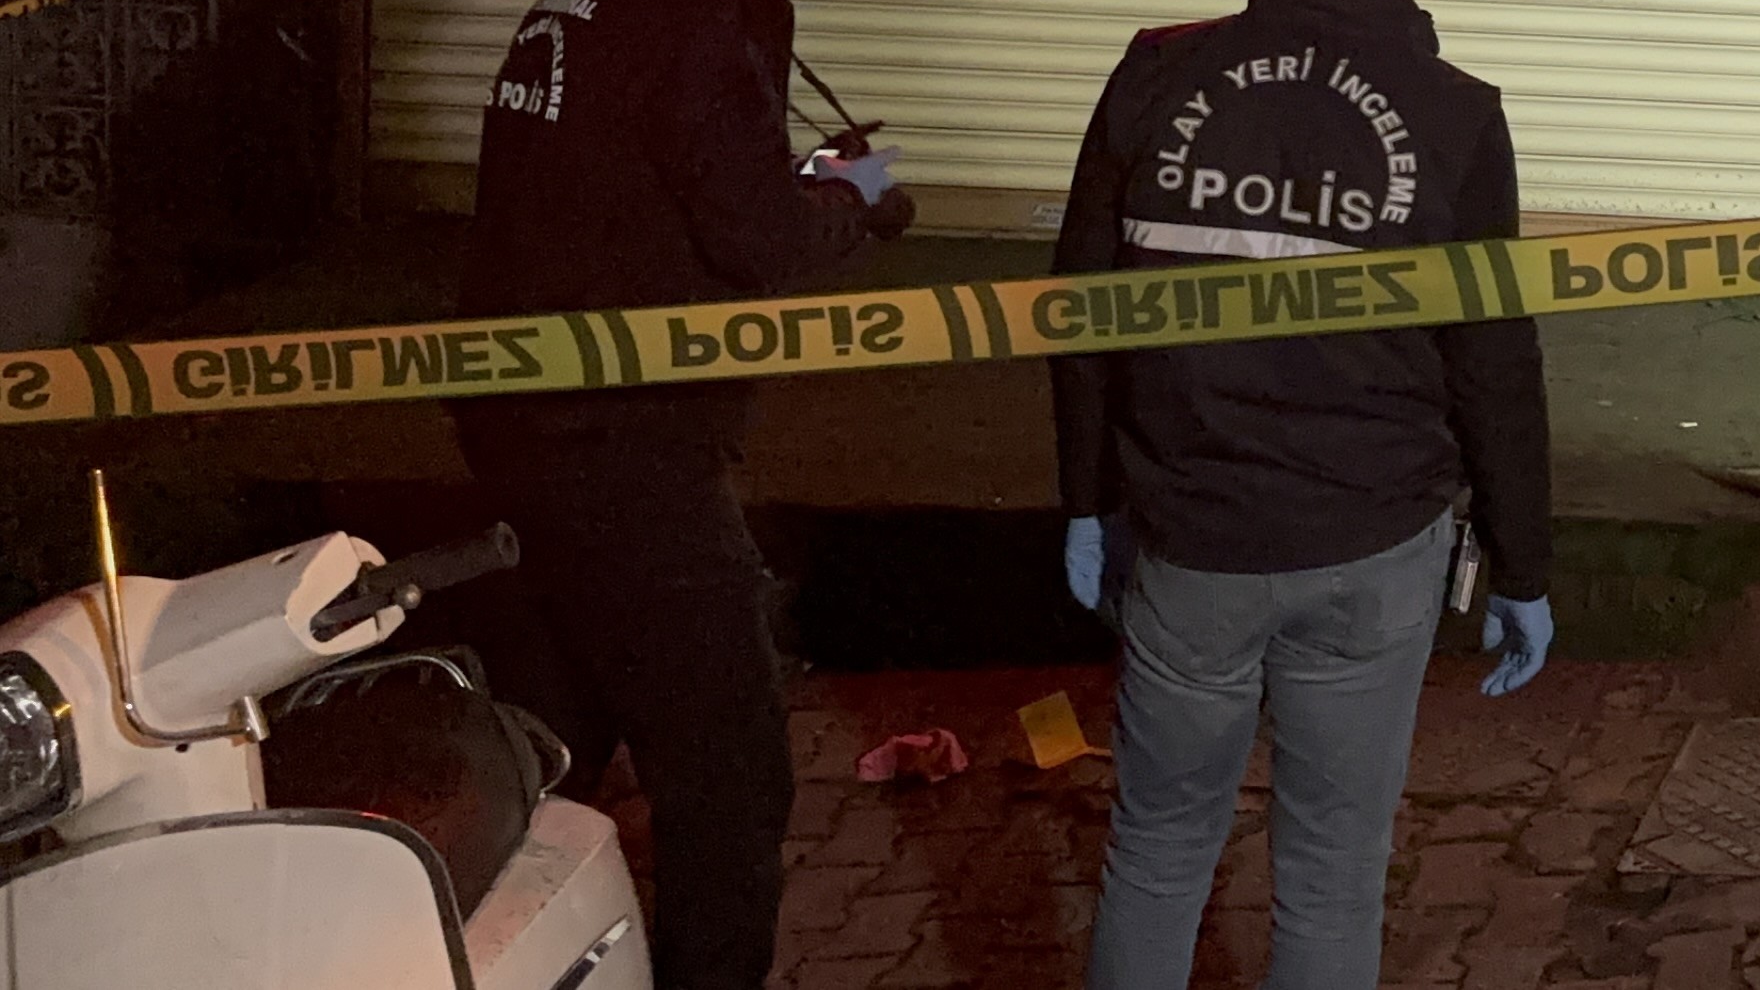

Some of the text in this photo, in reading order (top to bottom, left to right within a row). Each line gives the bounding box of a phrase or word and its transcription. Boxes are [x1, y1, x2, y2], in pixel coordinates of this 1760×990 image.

[1158, 46, 1417, 225] OLAY YERİ İNCELEME
[1190, 168, 1374, 233] POLİS
